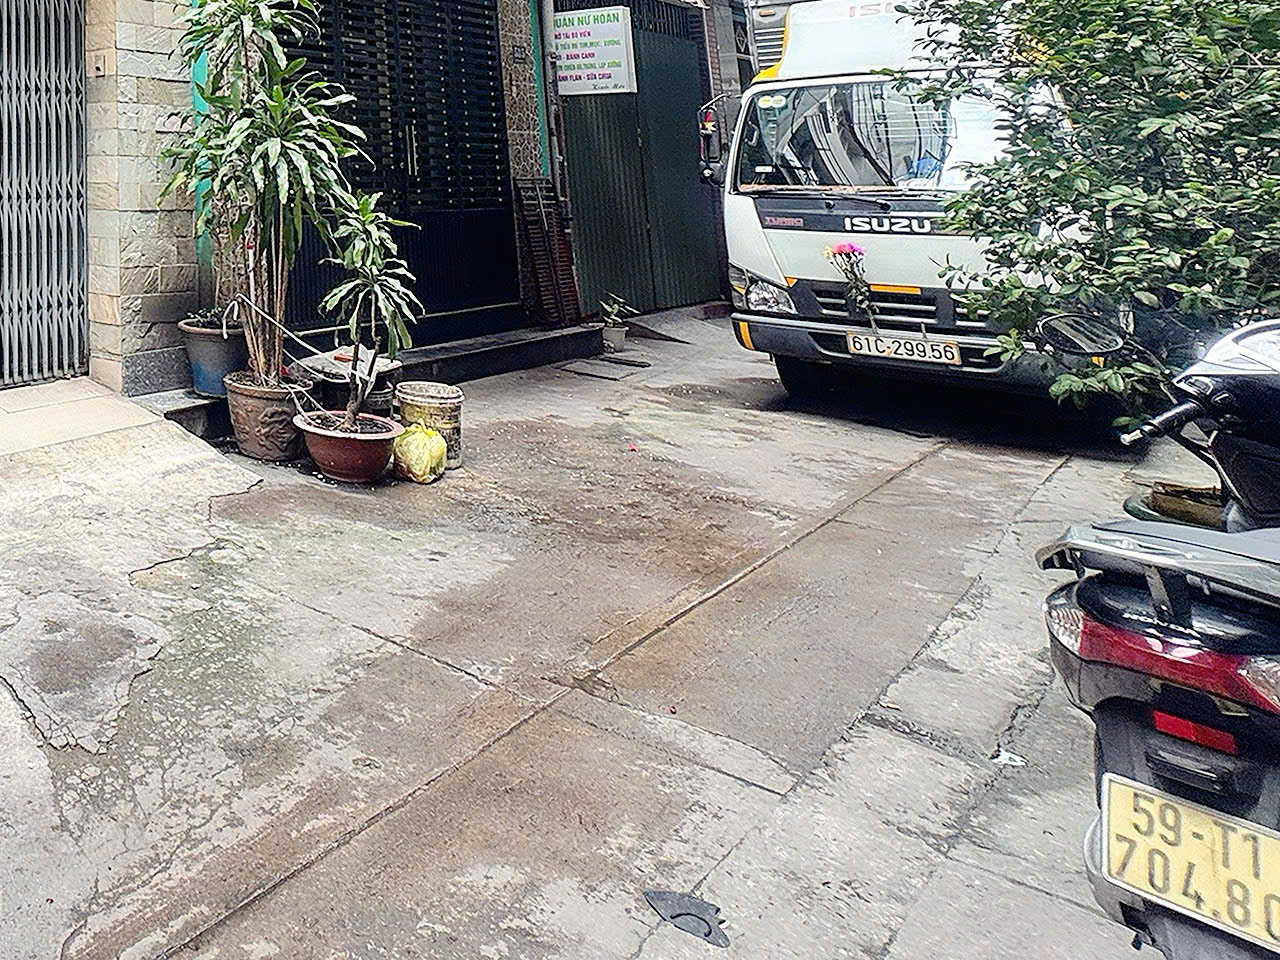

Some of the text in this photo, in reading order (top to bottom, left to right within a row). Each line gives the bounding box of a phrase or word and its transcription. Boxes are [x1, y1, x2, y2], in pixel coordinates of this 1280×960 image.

[844, 216, 932, 233] ISUZU
[851, 335, 955, 362] 61C-299.56
[1132, 792, 1261, 881] 59-T1
